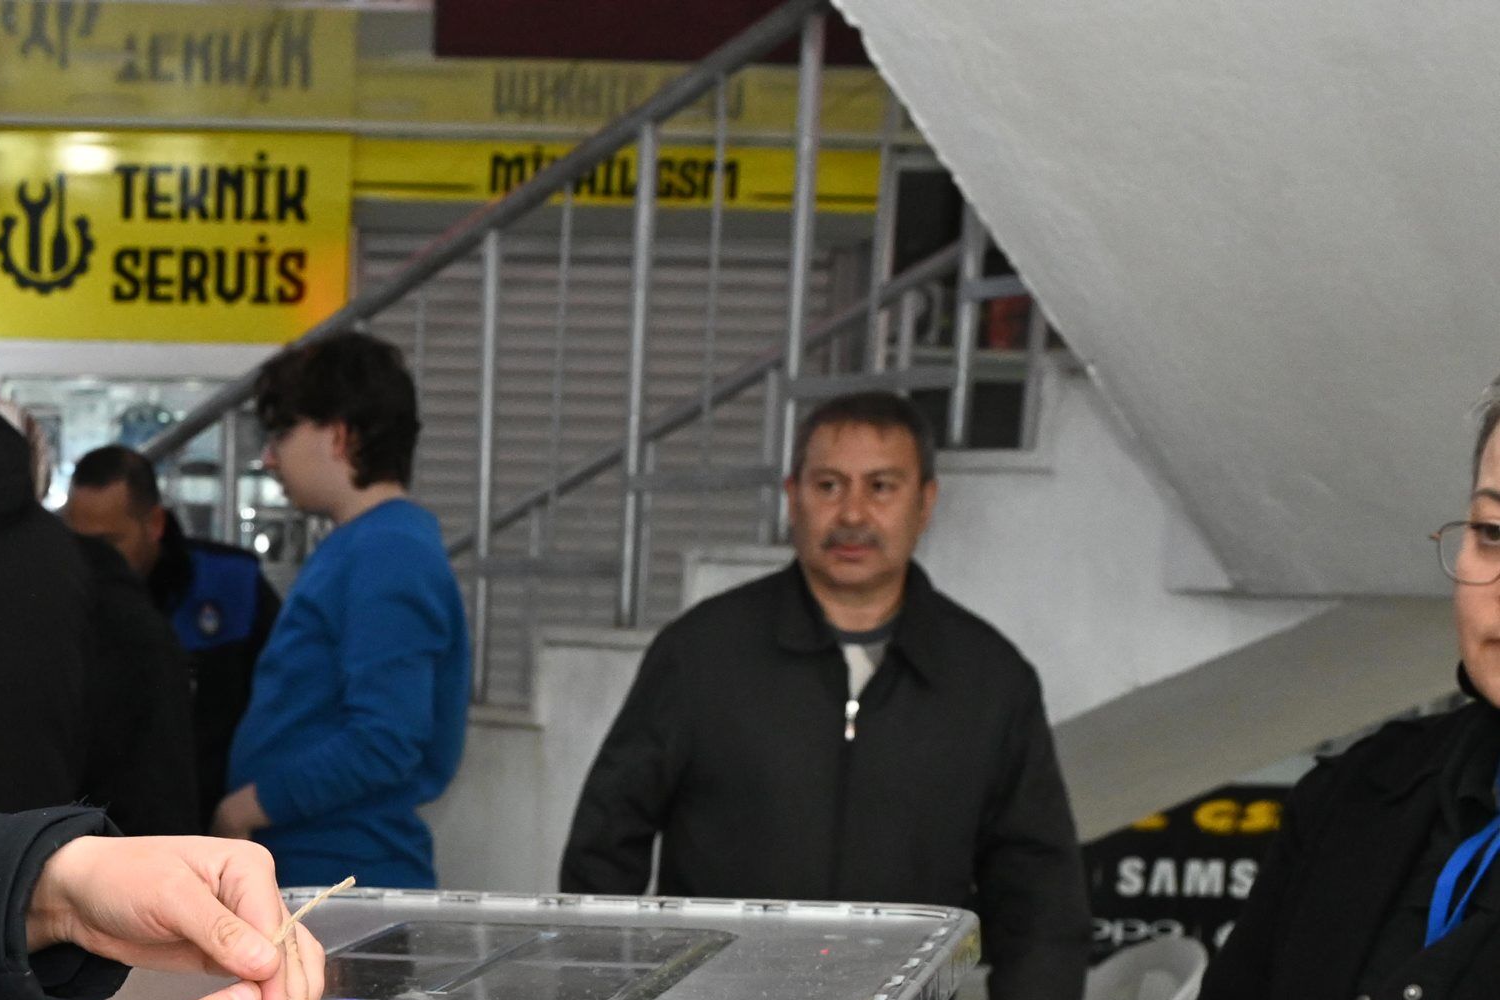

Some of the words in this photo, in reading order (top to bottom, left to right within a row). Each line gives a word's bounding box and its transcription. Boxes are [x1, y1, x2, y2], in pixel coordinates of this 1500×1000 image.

[113, 151, 308, 224] TEKNİK
[111, 234, 307, 305] SERVİS
[1116, 856, 1258, 899] SAMS
